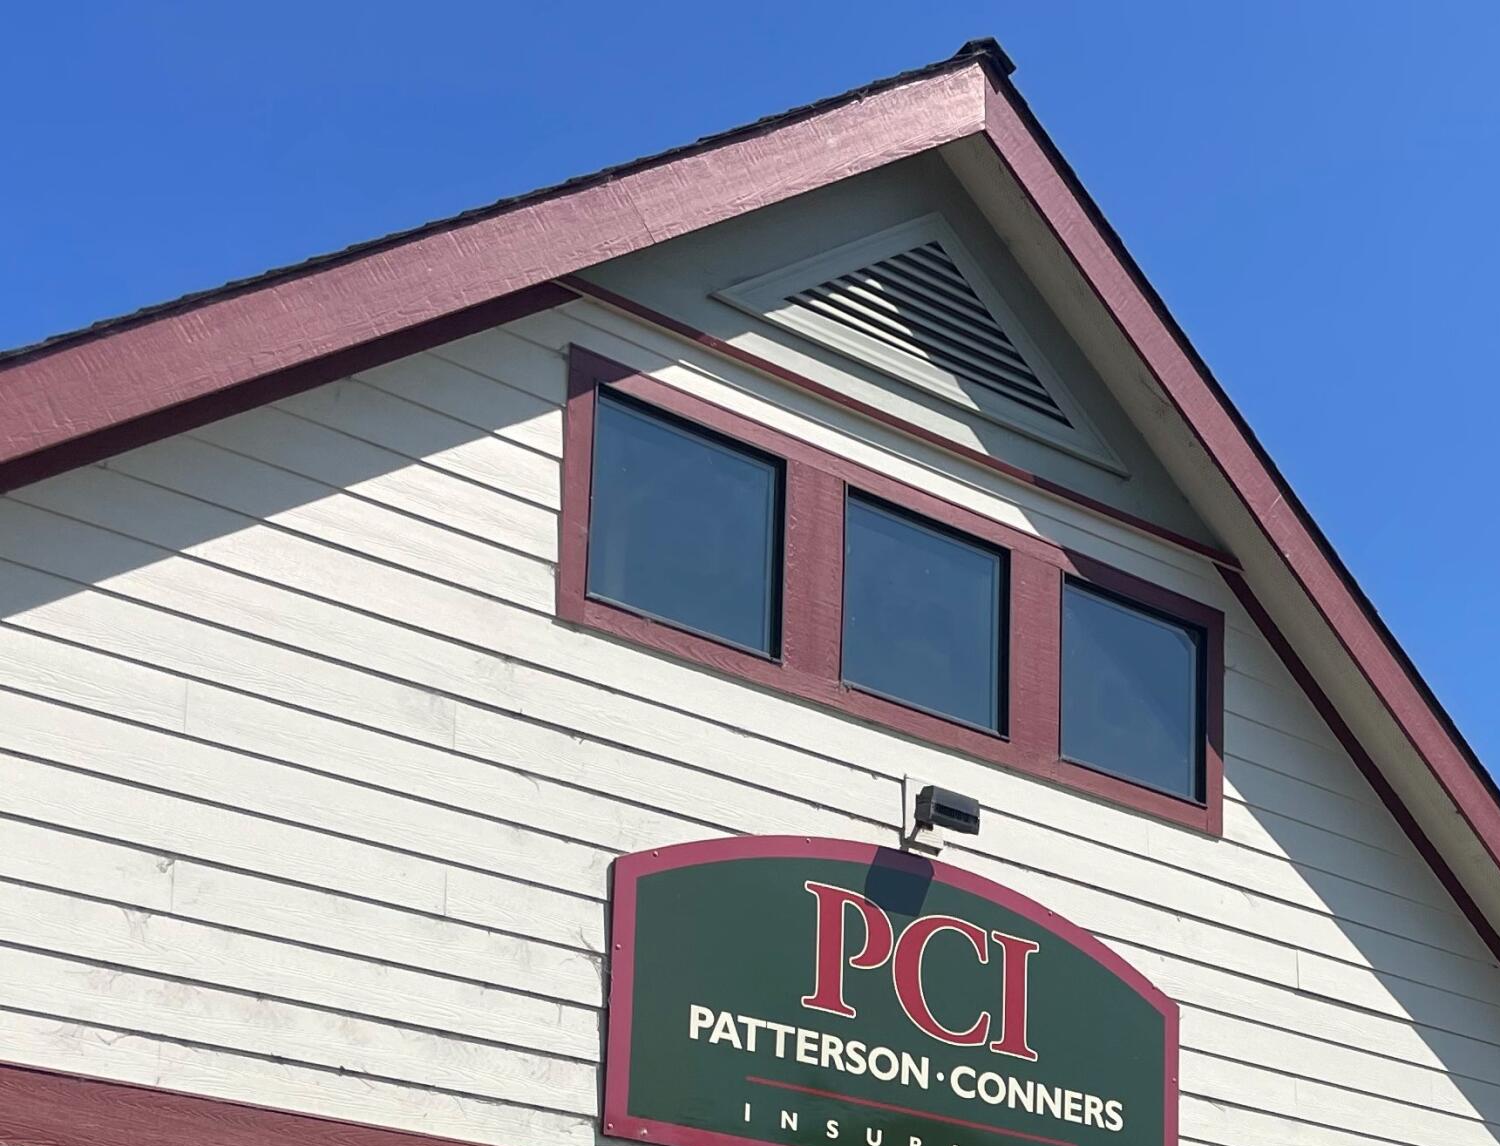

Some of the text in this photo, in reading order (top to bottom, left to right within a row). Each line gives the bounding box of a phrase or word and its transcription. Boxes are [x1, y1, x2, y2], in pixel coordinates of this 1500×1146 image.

[801, 880, 1039, 1061] PCI
[689, 1004, 929, 1090] PATTERSON
[950, 1066, 1124, 1132] CONNERS
